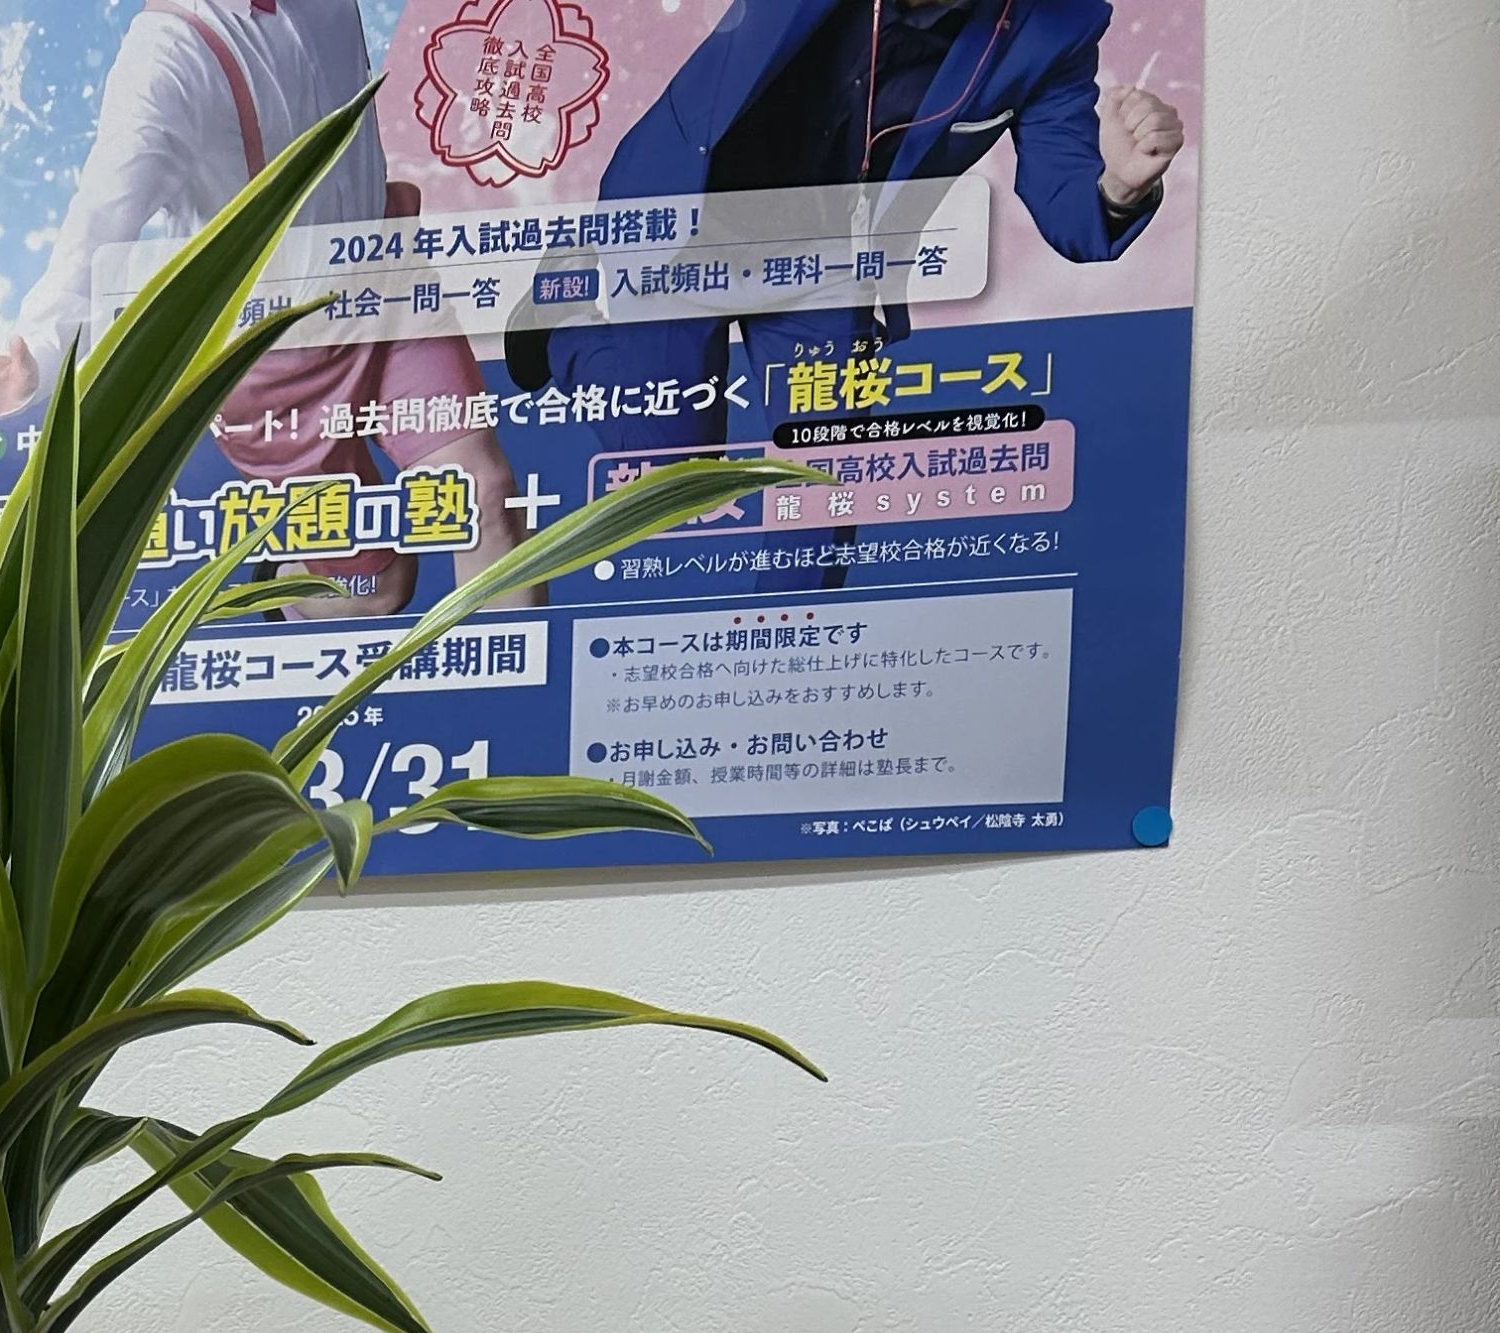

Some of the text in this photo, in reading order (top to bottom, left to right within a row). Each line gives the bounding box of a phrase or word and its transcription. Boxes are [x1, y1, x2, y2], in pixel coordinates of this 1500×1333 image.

[470, 35, 504, 117] 徹底攻略
[490, 40, 529, 141] 入試過去問
[521, 44, 556, 124] 全国高校
[538, 276, 589, 300] 新設!
[791, 412, 1028, 445] 10段階で合格レベルを視覚化!
[621, 531, 1060, 580] 習熟レベルが進むほど志望校合格が近くなる!
